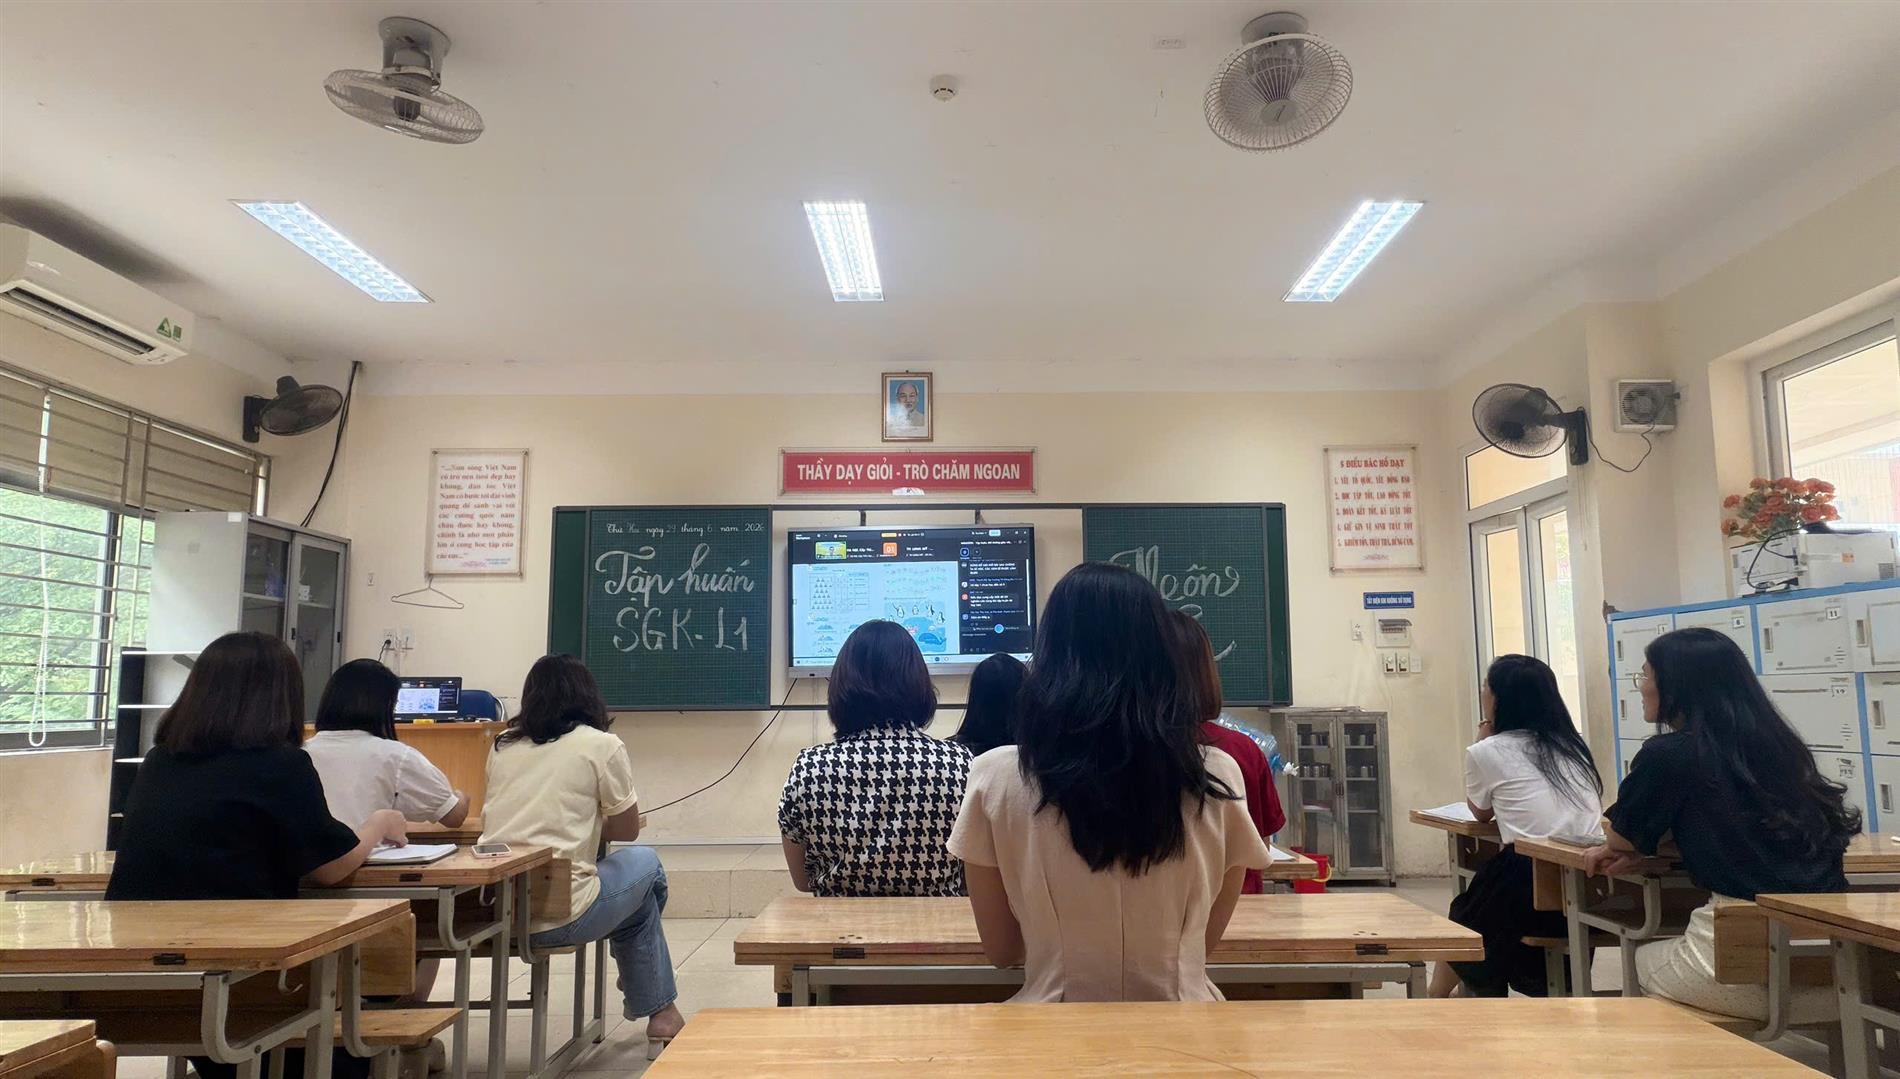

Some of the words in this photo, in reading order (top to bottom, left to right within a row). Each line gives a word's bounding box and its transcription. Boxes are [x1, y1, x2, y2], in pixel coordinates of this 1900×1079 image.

[797, 456, 832, 480] THẦY
[836, 464, 863, 485] DẠY
[867, 456, 893, 480] GIỎI
[903, 460, 929, 480] TRÒ
[932, 460, 970, 480] CHĂM
[974, 464, 1020, 480] NGOAN
[595, 546, 674, 608] Tập
[678, 543, 754, 594] huấn
[1829, 610, 1838, 618] 11
